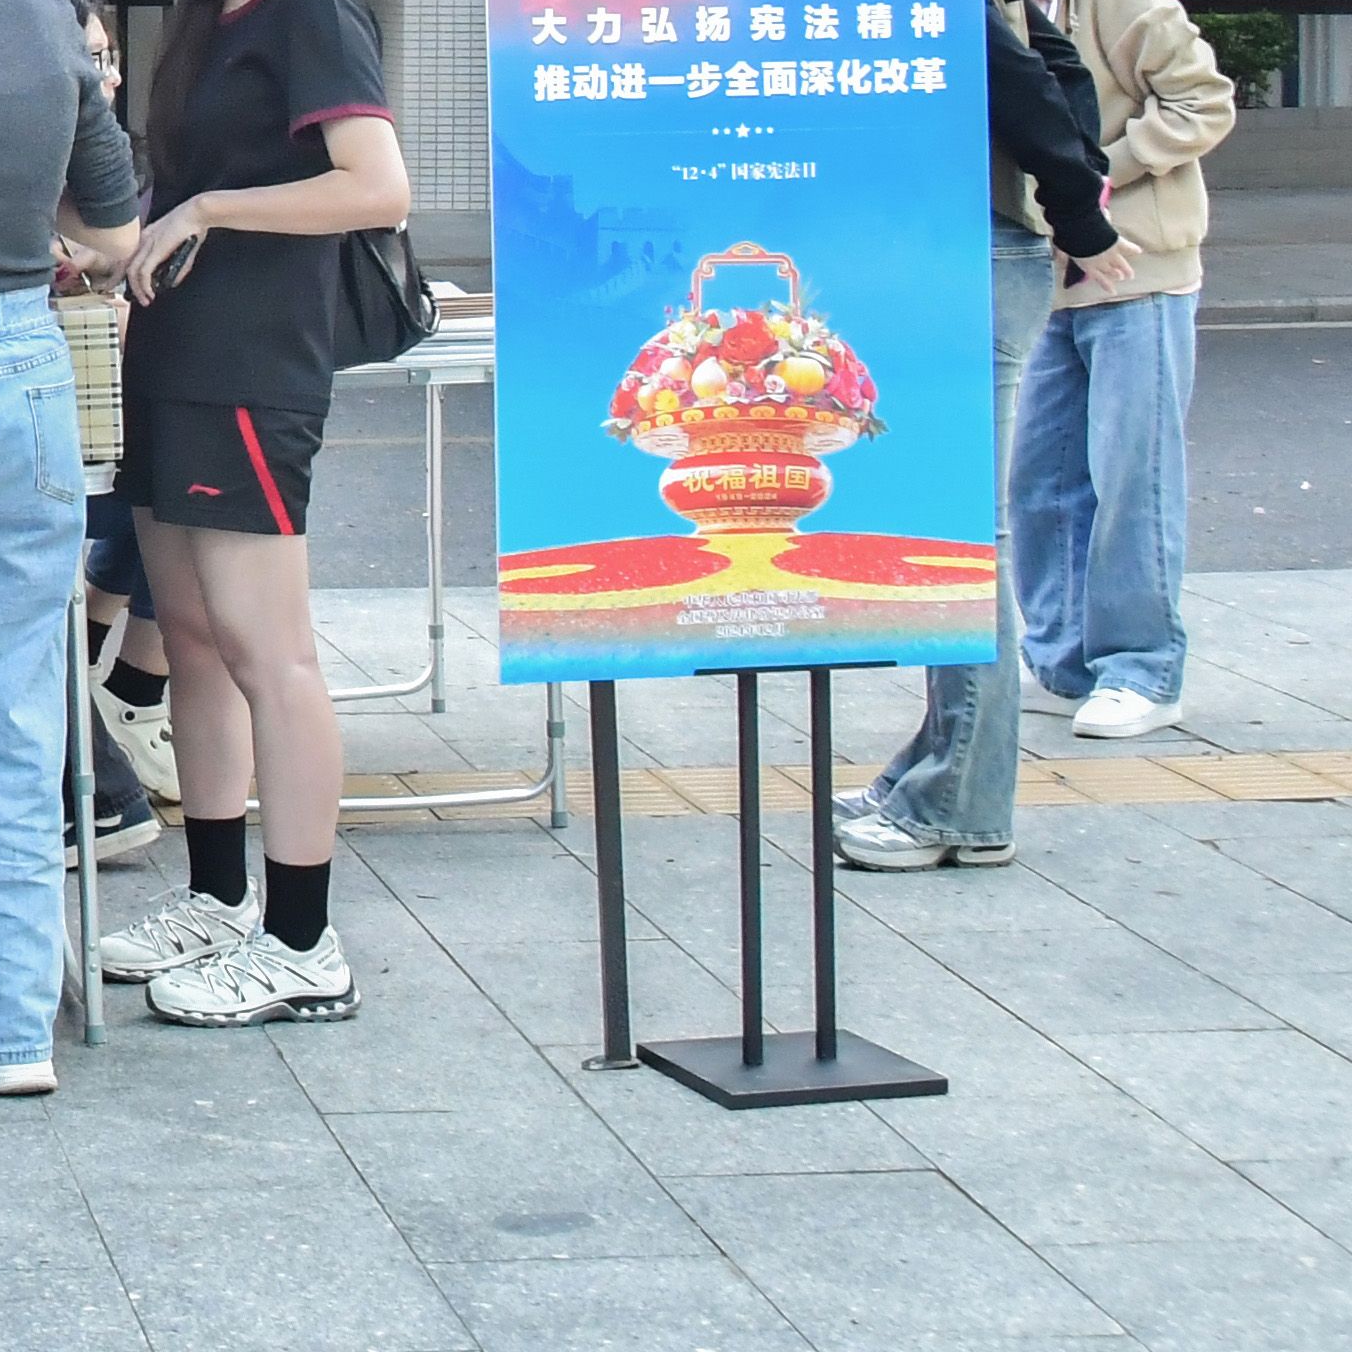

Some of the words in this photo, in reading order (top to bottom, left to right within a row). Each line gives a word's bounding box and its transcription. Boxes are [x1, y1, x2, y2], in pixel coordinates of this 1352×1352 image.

[532, 2, 946, 45] 大力弘扬宪法精神
[534, 57, 947, 101] 推动进一步全面深化改革
[682, 463, 812, 493] 祝福祖国
